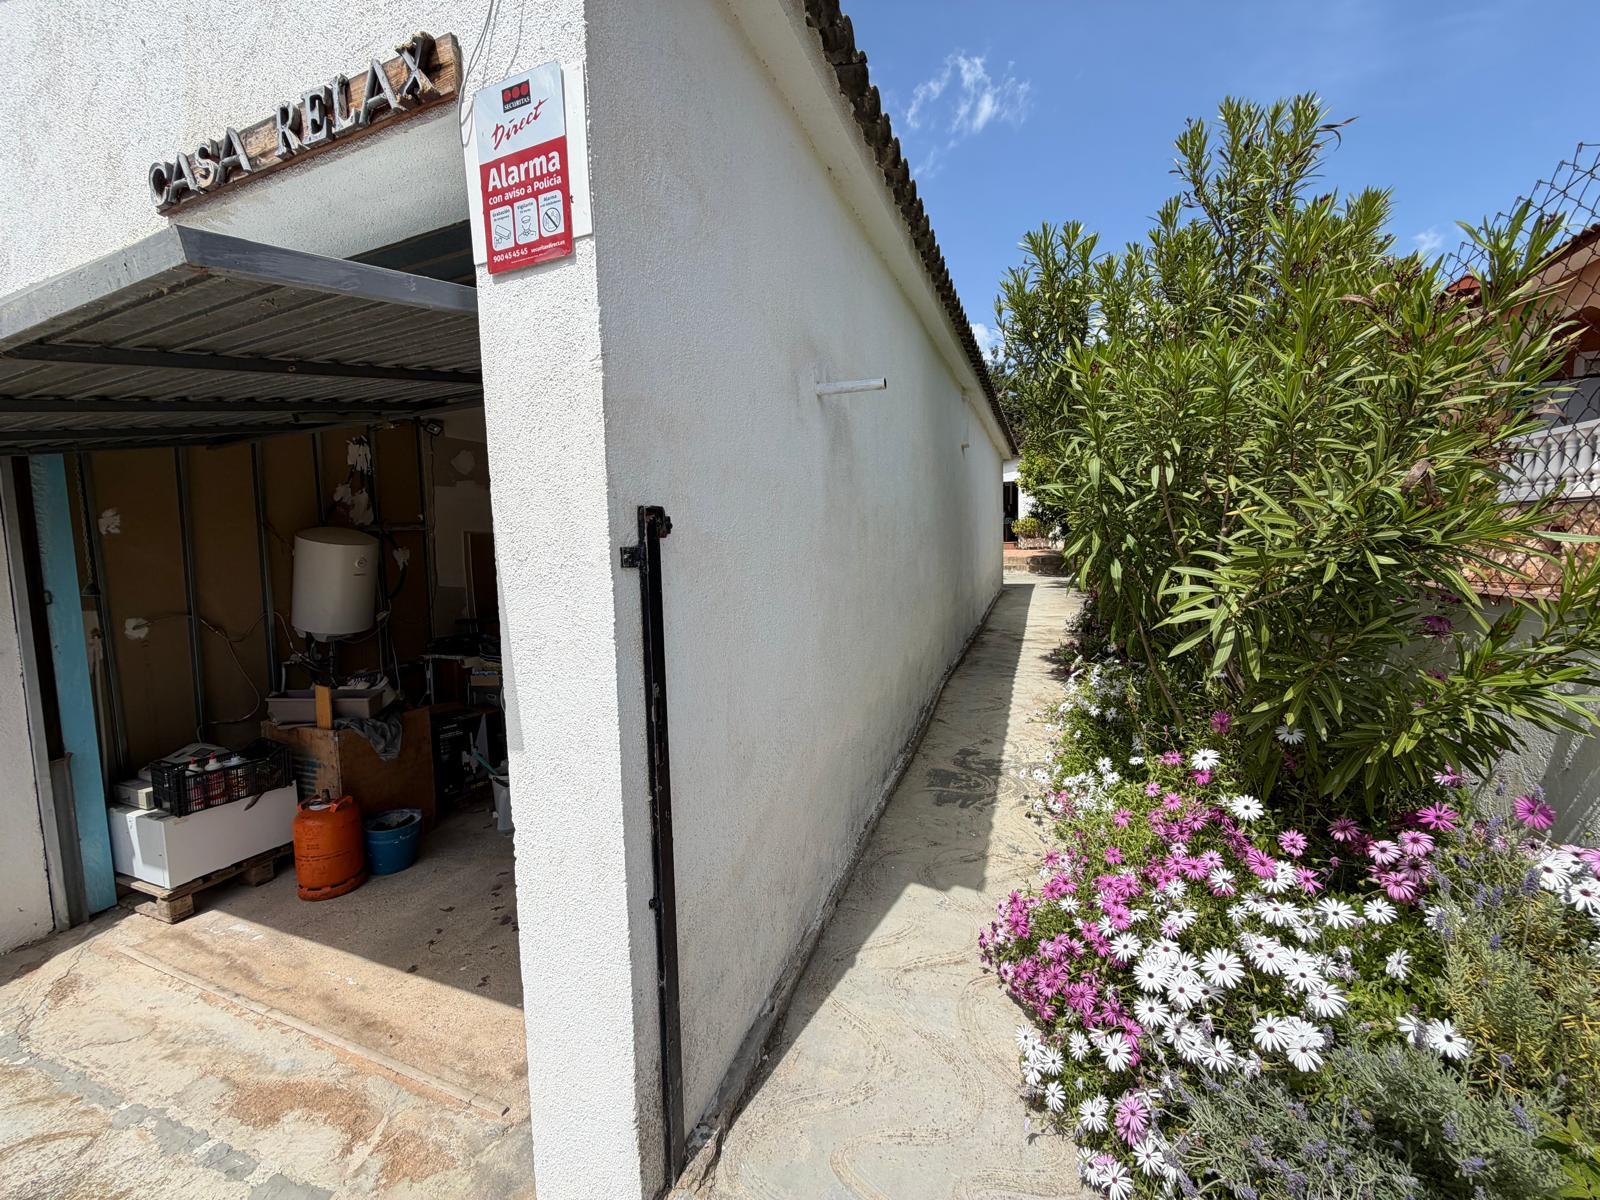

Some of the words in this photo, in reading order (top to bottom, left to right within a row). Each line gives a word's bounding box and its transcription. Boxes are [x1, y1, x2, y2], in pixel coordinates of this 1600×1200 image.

[149, 127, 252, 207] CASA
[273, 31, 442, 160] RELAX
[504, 97, 530, 111] SECURITAS
[491, 97, 549, 150] Direct
[488, 150, 561, 192] Alarma
[488, 194, 503, 205] con
[504, 186, 525, 201] aviso
[526, 184, 532, 194] a
[533, 173, 562, 192] Policía
[493, 254, 505, 263] 900
